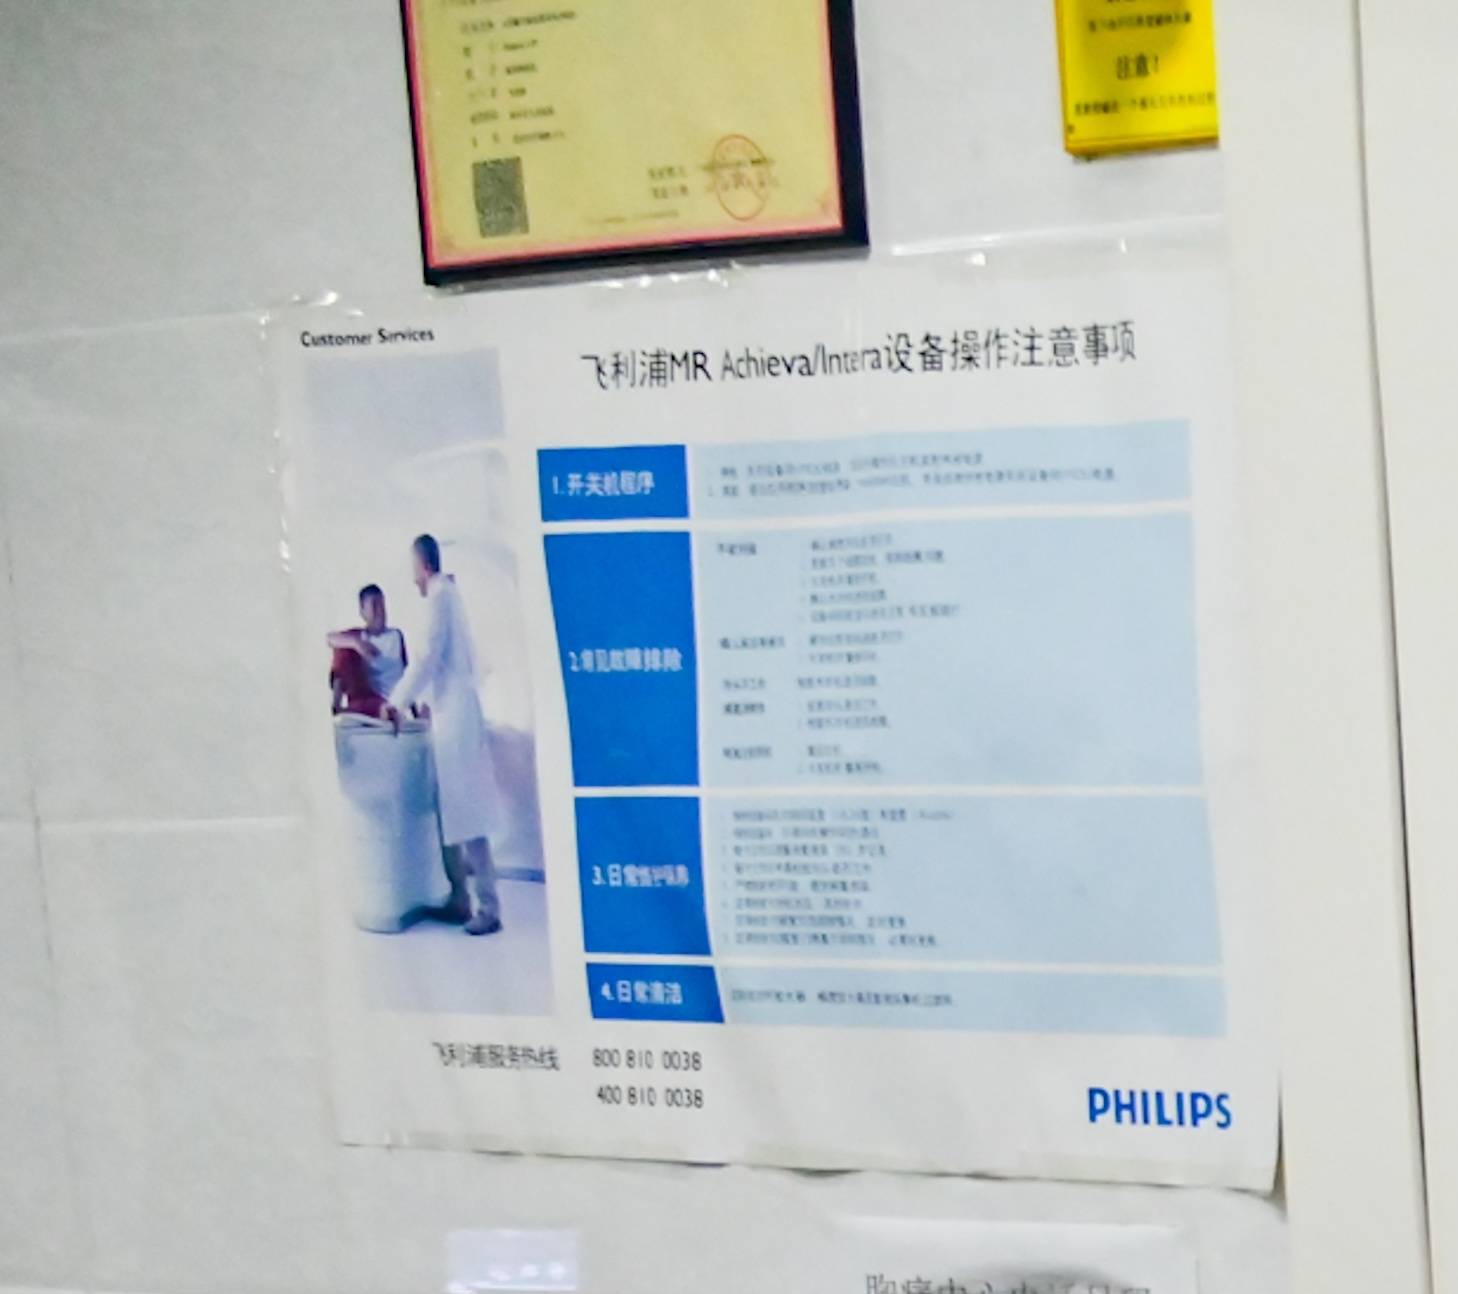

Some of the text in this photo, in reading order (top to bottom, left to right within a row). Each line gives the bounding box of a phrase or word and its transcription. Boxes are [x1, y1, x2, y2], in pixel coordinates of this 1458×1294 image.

[300, 327, 436, 348] Customer Services
[592, 1048, 622, 1068] 800
[625, 1048, 655, 1069] 810
[662, 1049, 703, 1071] 0038
[596, 1085, 705, 1109] 400 810 0038
[1088, 1086, 1232, 1130] PHILIPS
